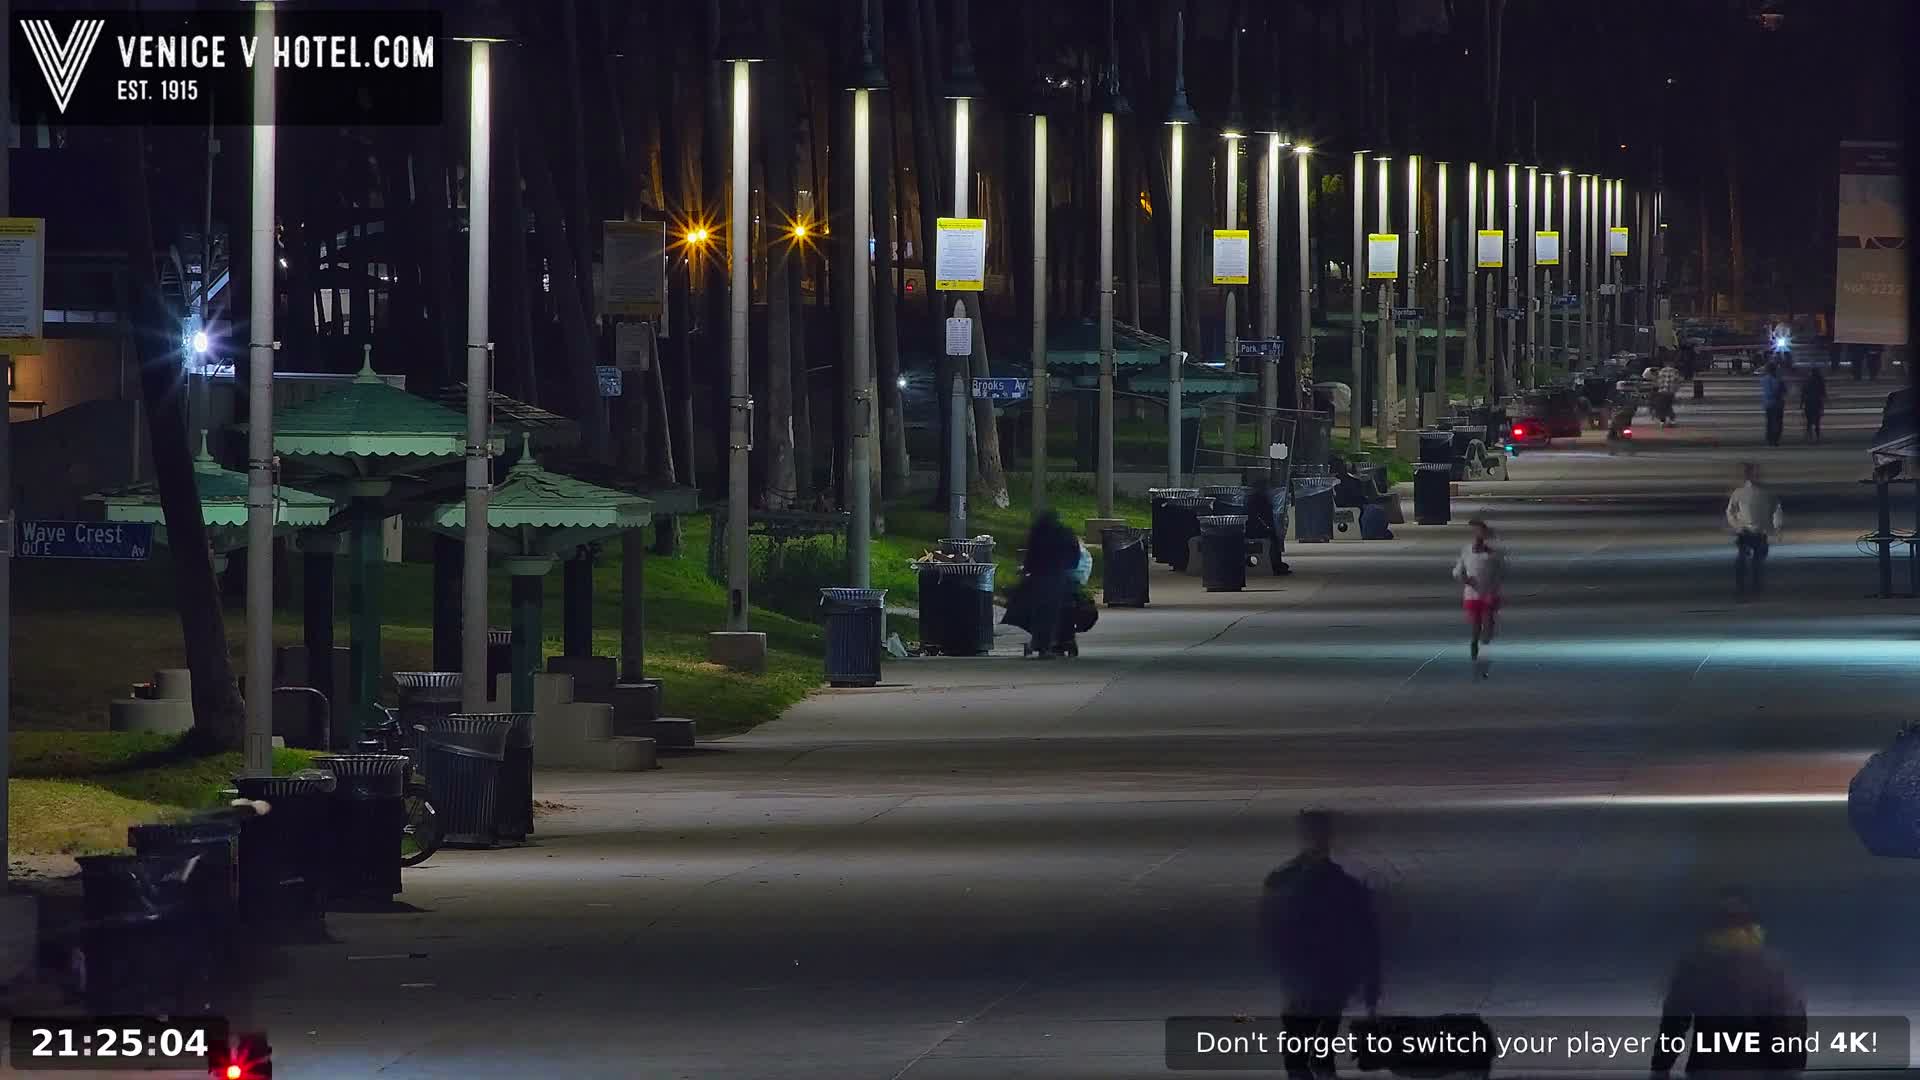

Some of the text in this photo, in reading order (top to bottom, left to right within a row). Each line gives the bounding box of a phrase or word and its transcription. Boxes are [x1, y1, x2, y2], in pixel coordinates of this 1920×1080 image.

[1241, 344, 1257, 353] Park
[972, 379, 1026, 391] Brooks Av
[22, 522, 123, 543] Wave Crest
[131, 544, 146, 557] Av
